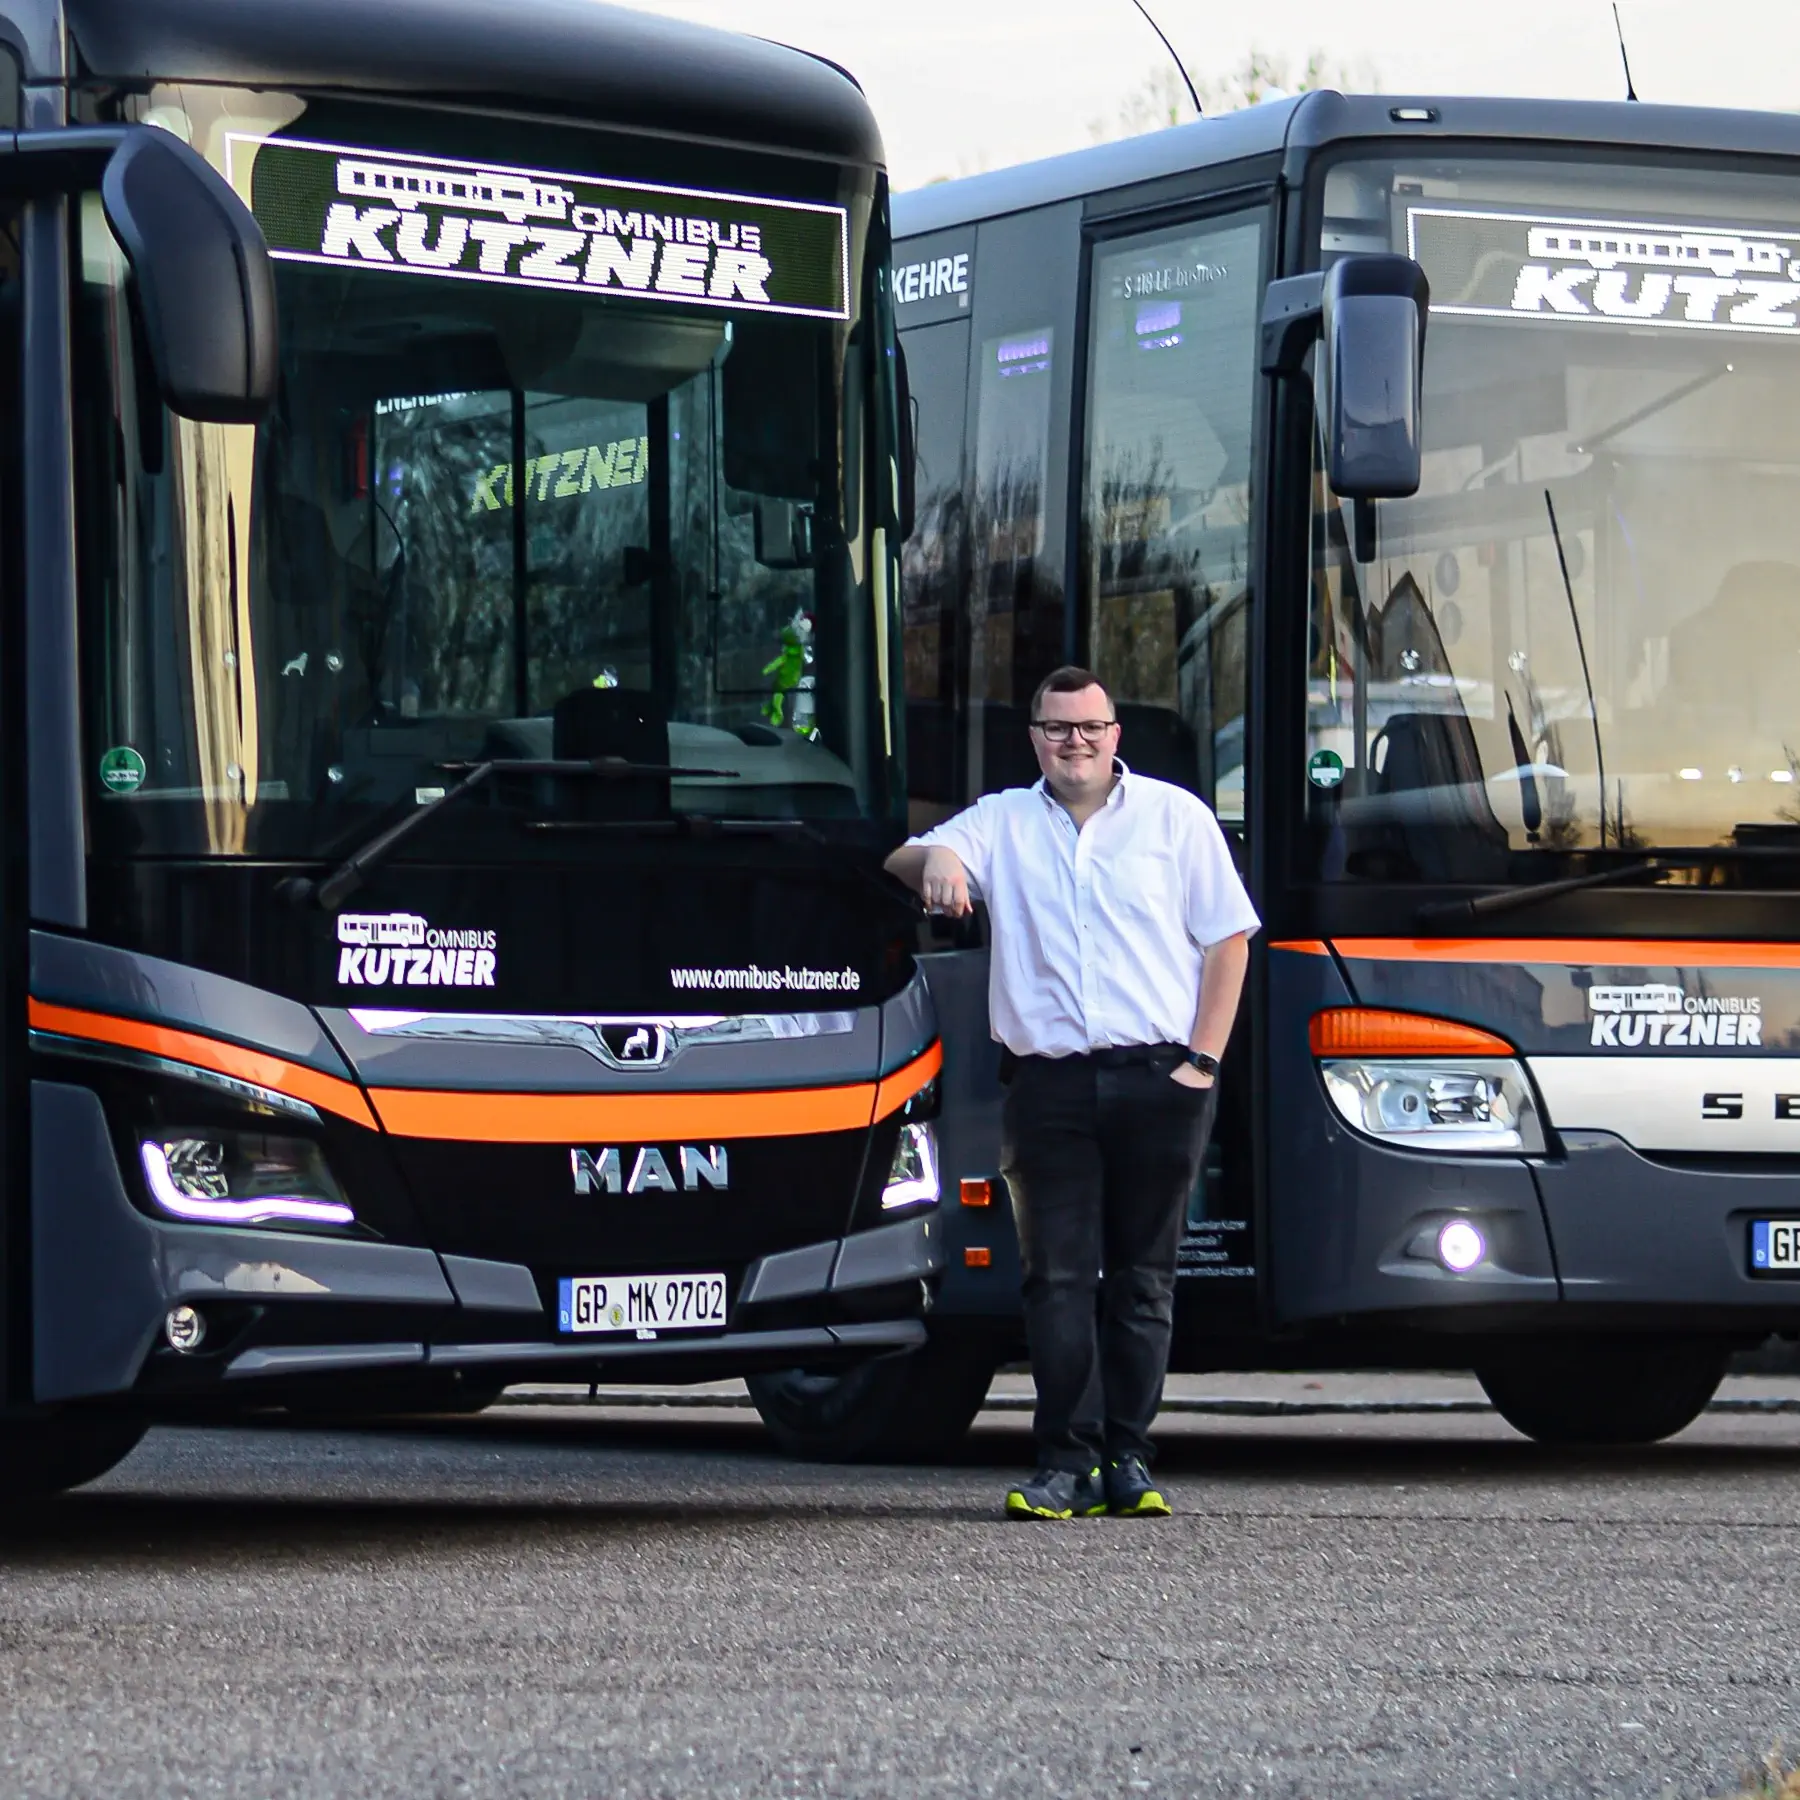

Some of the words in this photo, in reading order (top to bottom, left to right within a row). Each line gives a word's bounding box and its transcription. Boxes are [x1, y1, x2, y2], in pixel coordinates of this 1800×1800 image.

[571, 205, 762, 251] OMNIBUS
[322, 203, 772, 302] KUTZNER
[879, 253, 969, 304] KEHRE
[426, 929, 496, 949] OMNIBUS
[338, 948, 496, 986] KUTZNER
[671, 965, 860, 990] www.omnibus-kutzner.de
[1684, 997, 1761, 1014] OMNIBUS
[1590, 1014, 1762, 1046] KUTZNER
[571, 1145, 729, 1194] MAN
[576, 1284, 607, 1324] GP
[628, 1282, 658, 1322] MK
[666, 1280, 723, 1321] 9702
